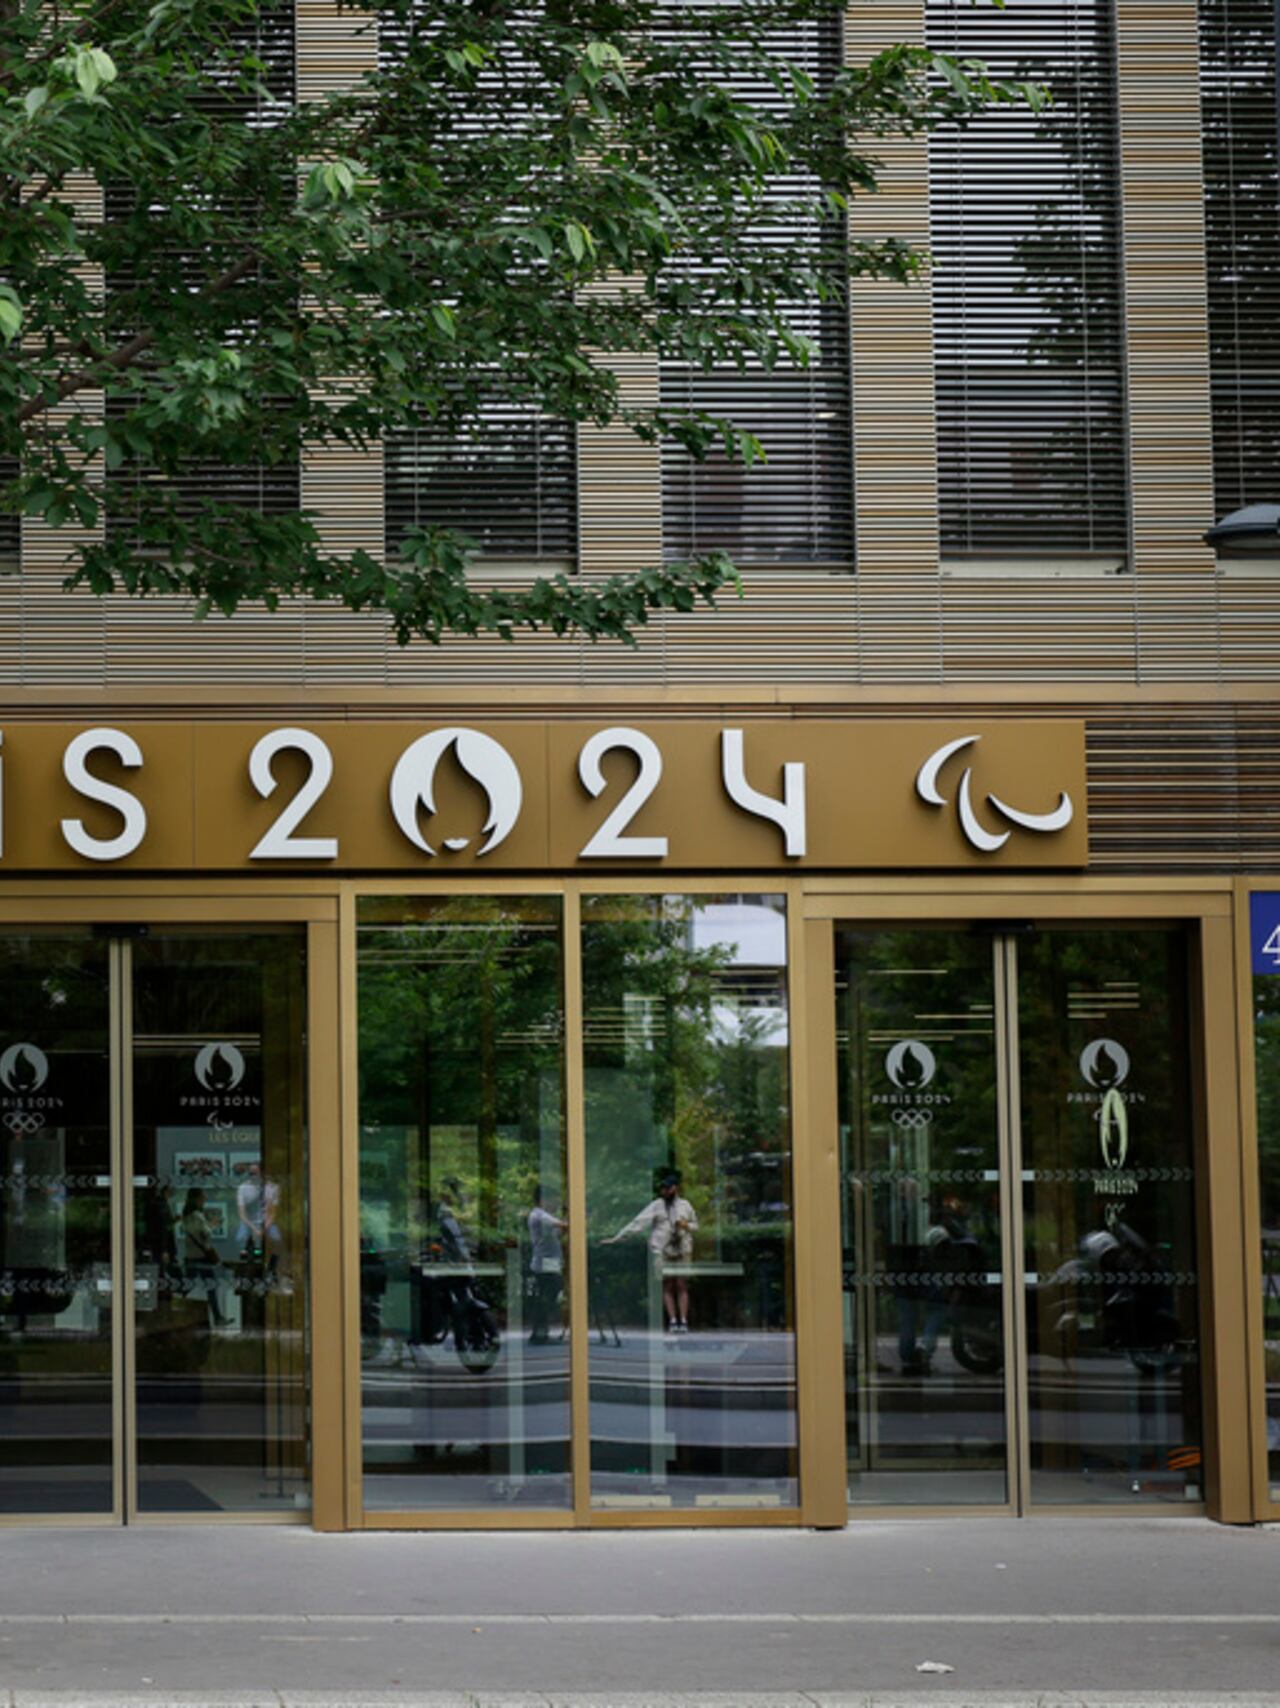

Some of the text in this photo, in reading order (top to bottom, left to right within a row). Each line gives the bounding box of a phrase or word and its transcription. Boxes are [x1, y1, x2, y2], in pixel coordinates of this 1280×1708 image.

[248, 726, 806, 858] 2024
[179, 1095, 261, 1107] PARIS 2024
[872, 1094, 951, 1105] PARIS 2024
